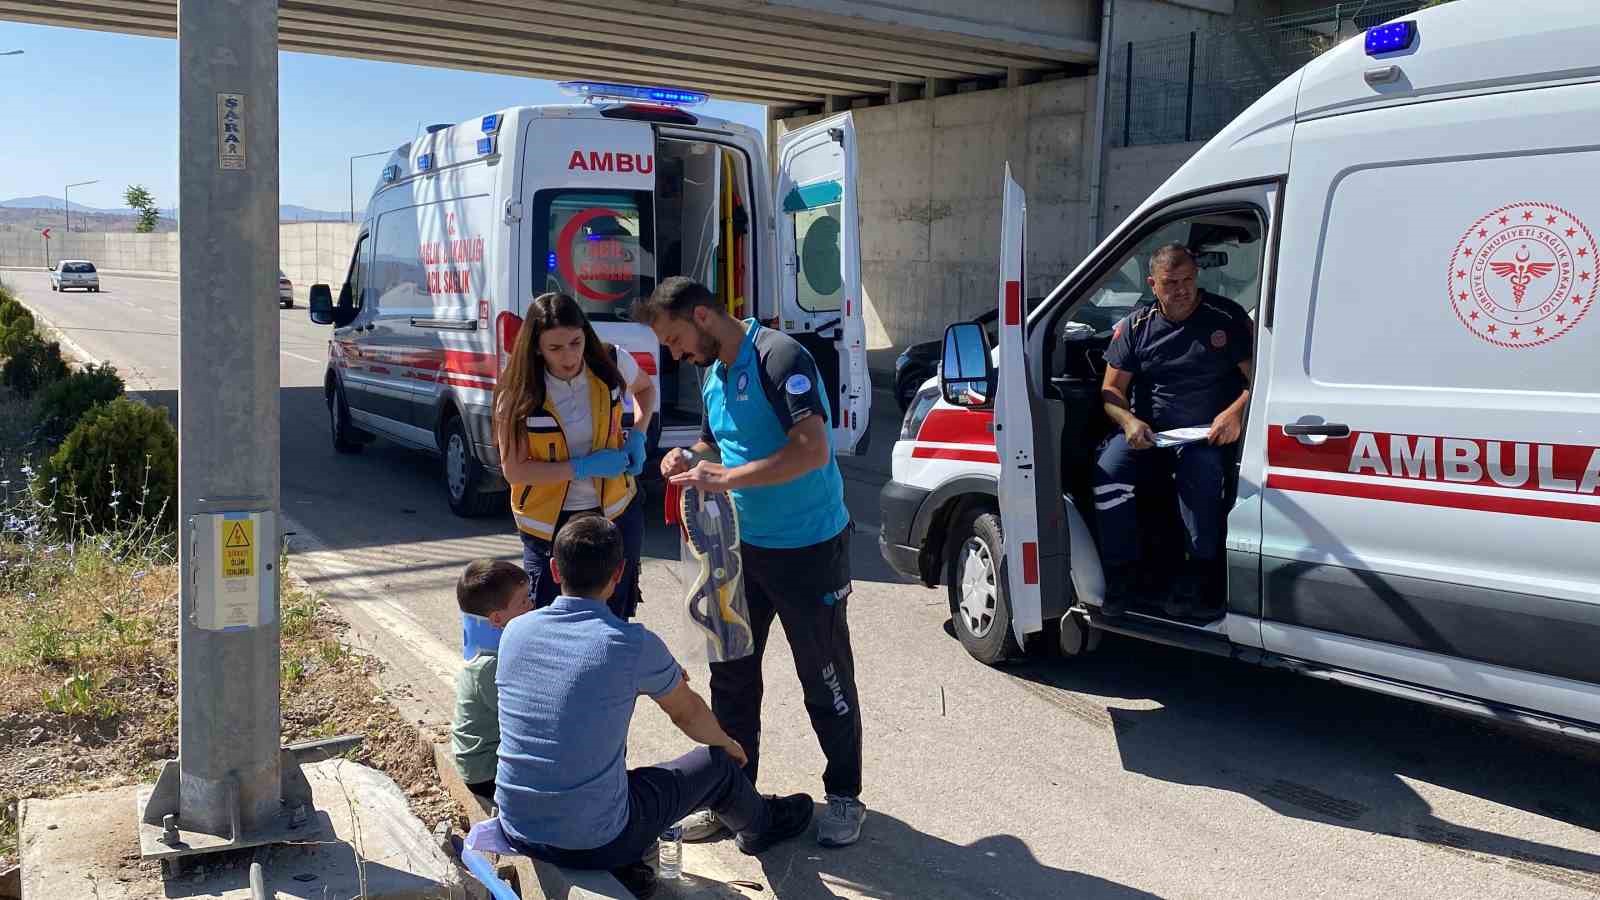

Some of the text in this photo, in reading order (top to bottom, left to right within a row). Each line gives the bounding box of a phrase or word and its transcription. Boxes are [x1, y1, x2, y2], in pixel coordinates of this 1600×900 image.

[568, 150, 653, 174] AMBU
[1537, 231, 1568, 260] SAĞLIK
[822, 662, 848, 715] UMKE
